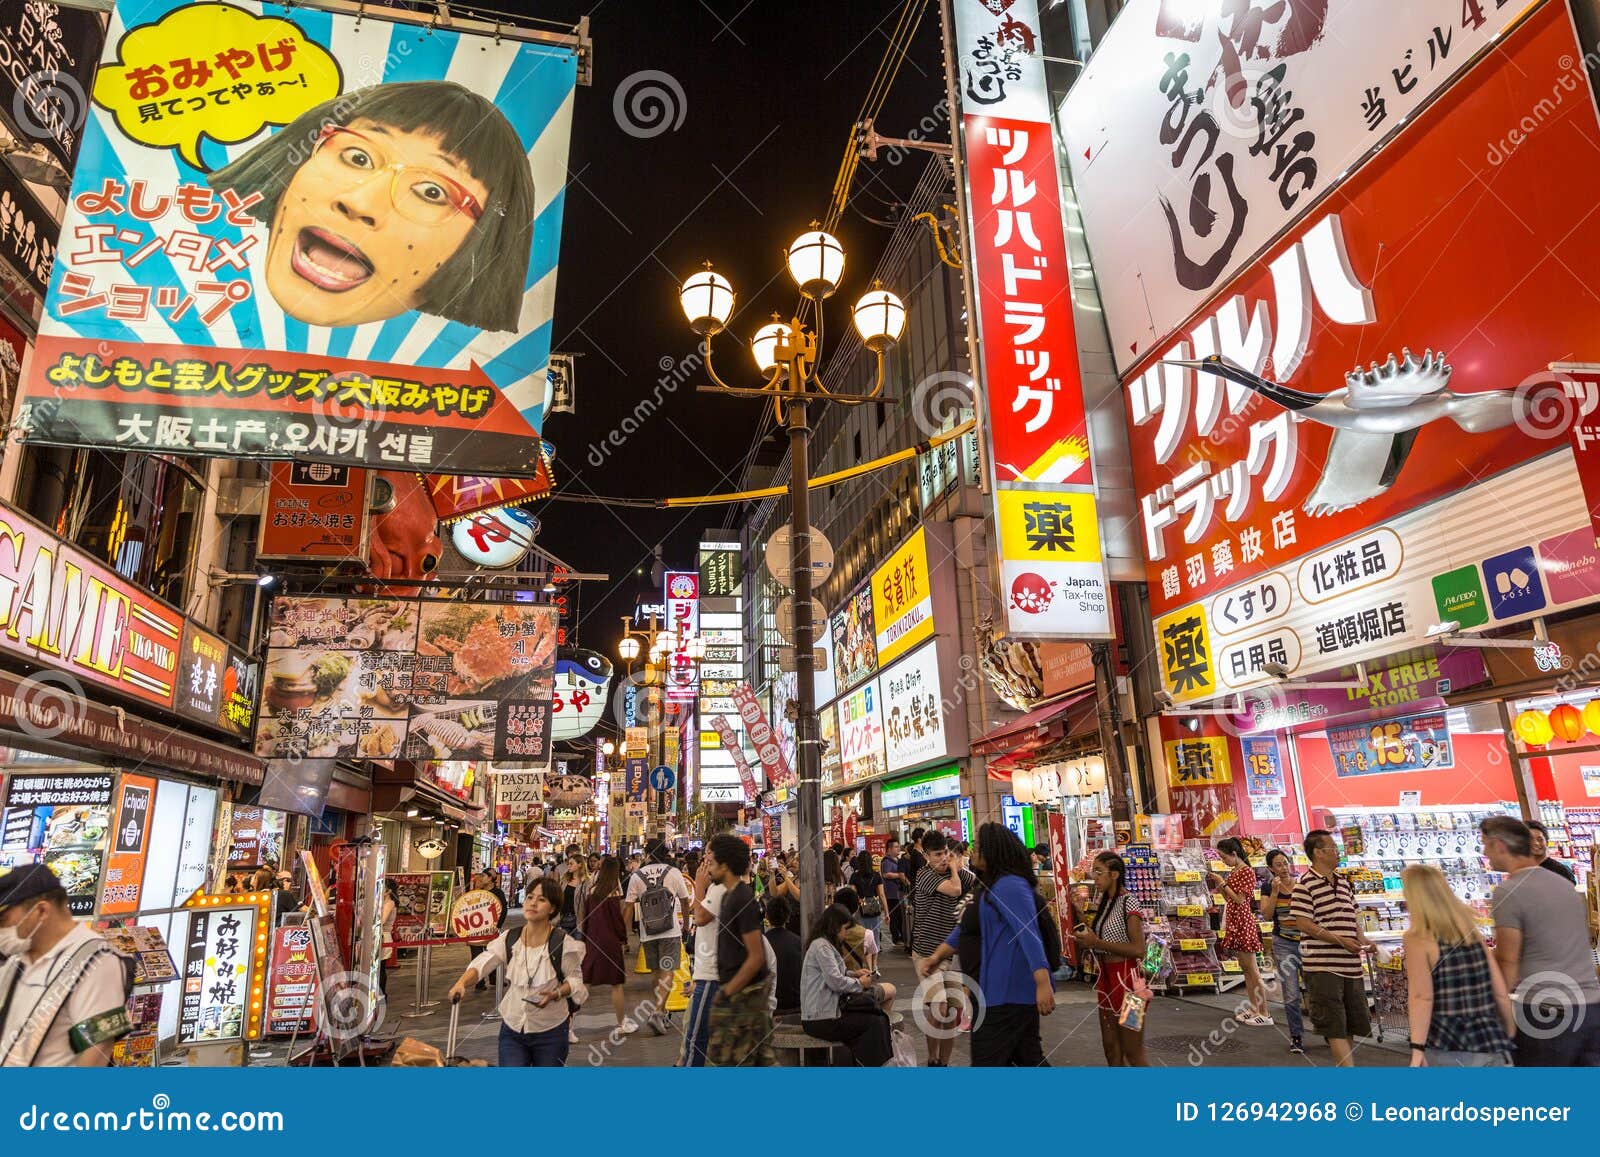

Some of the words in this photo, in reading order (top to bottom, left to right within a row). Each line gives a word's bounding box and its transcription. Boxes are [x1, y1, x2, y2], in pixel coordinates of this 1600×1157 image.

[126, 37, 298, 101] おみやげ
[1361, 0, 1508, 131] 当ビル4
[1155, 52, 1248, 290] まつり
[75, 177, 265, 227] よしもと
[69, 222, 260, 272] エンタメ
[56, 272, 251, 327] ショップ
[986, 127, 1061, 433] ツルハドラッグ
[1129, 213, 1377, 464] ツルハ
[49, 353, 490, 418] よしもと芸人グッズ・大阪みやげ
[379, 430, 433, 463] 선물
[1141, 408, 1309, 562] ドラッグ
[274, 512, 355, 529] お好み焼き
[1023, 502, 1075, 552] 薬
[1160, 509, 1298, 600] 鶴羽藥妝店
[1312, 540, 1388, 595] 化粧品
[1062, 589, 1104, 602] Tax-free
[1066, 576, 1102, 588] Japan.
[1443, 590, 1477, 607] SHISEIDO
[886, 605, 920, 644] TORIKIZOKU
[1079, 601, 1105, 614] Shop
[1223, 583, 1278, 625] くすり
[1316, 601, 1406, 654] 道頓堀店
[128, 629, 175, 672] NIKO-NIKO
[1163, 615, 1210, 695] 薬
[1231, 637, 1289, 679] 日用品
[1347, 672, 1387, 701] TAX
[1388, 658, 1441, 687] FREE
[1369, 685, 1419, 709] STORE
[752, 726, 768, 738] INFO
[842, 717, 881, 758] レインボー
[1330, 728, 1366, 743] SUMMER
[501, 774, 540, 785] PASTA
[1175, 742, 1214, 781] 薬
[10, 792, 109, 804] 本場大阪のお好み焼き
[13, 777, 111, 790] 道頓堀川を眺めながら
[502, 791, 539, 802] PIZZA
[707, 790, 732, 798] ZAZA
[910, 785, 933, 799] FamilyMart
[528, 807, 541, 816] 2F
[454, 902, 500, 934] NO.1
[208, 913, 242, 1005] お好み焼
